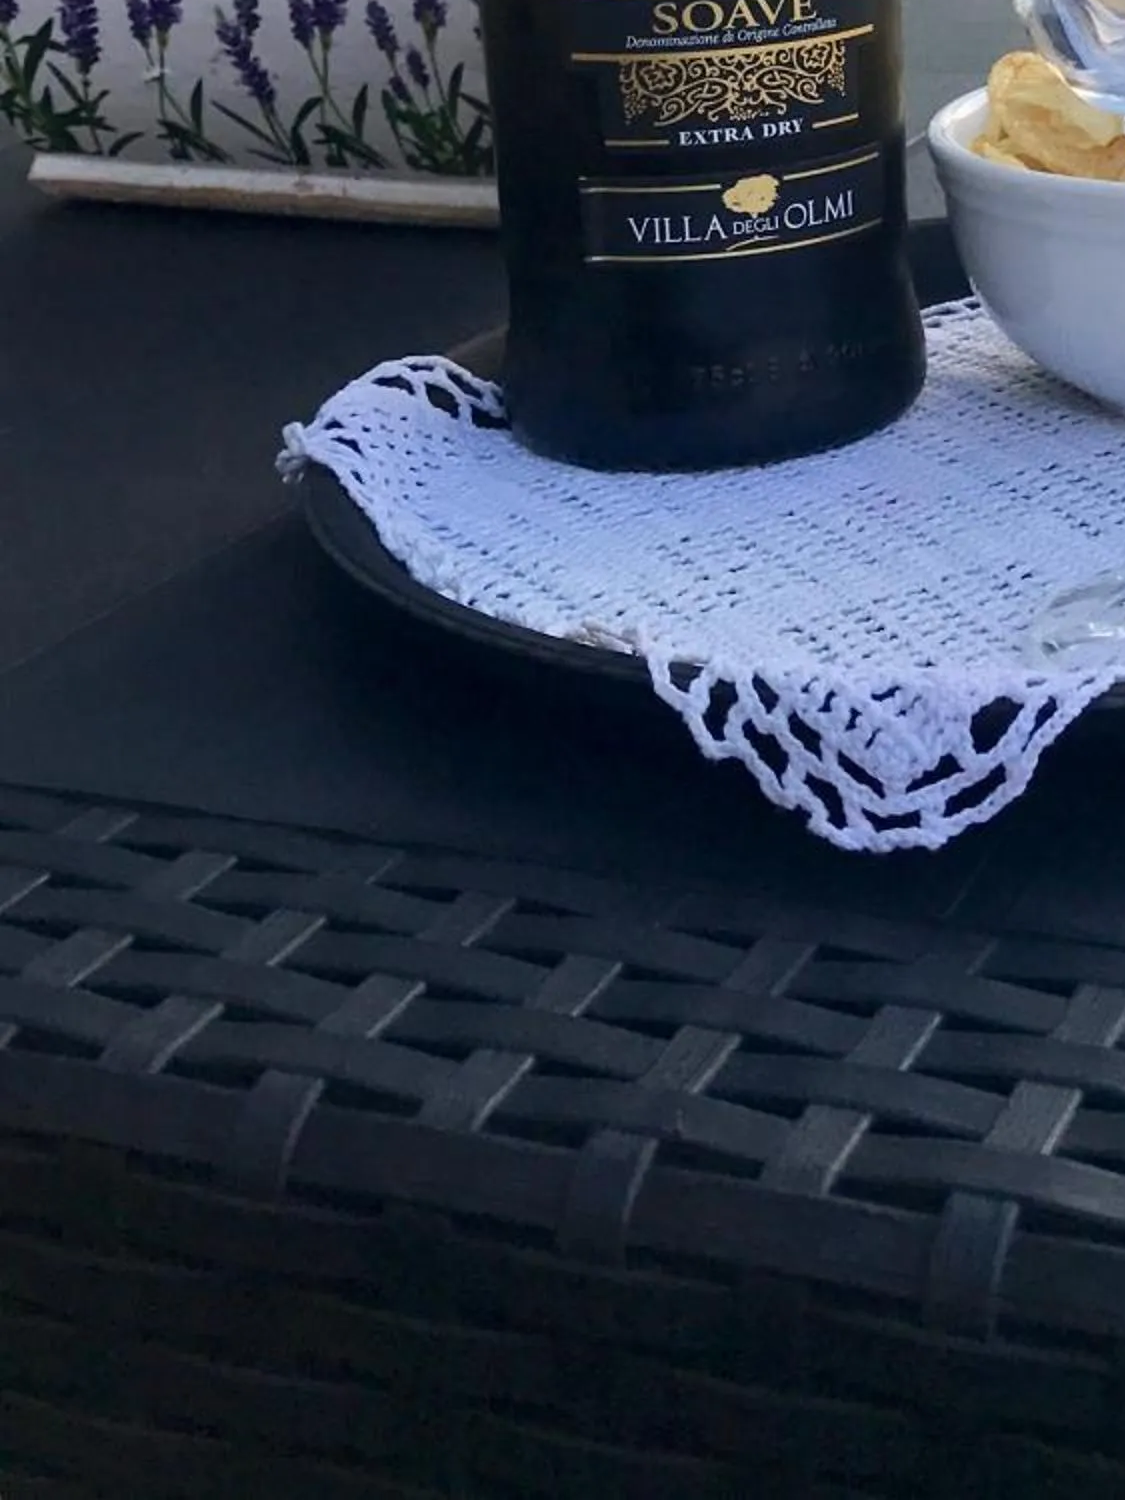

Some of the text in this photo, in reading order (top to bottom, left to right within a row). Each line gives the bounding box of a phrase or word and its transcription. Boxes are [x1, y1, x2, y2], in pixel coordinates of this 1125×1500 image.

[679, 118, 803, 146] EXTRA DRY
[627, 190, 854, 243] VILLA DEGLI OLMI
